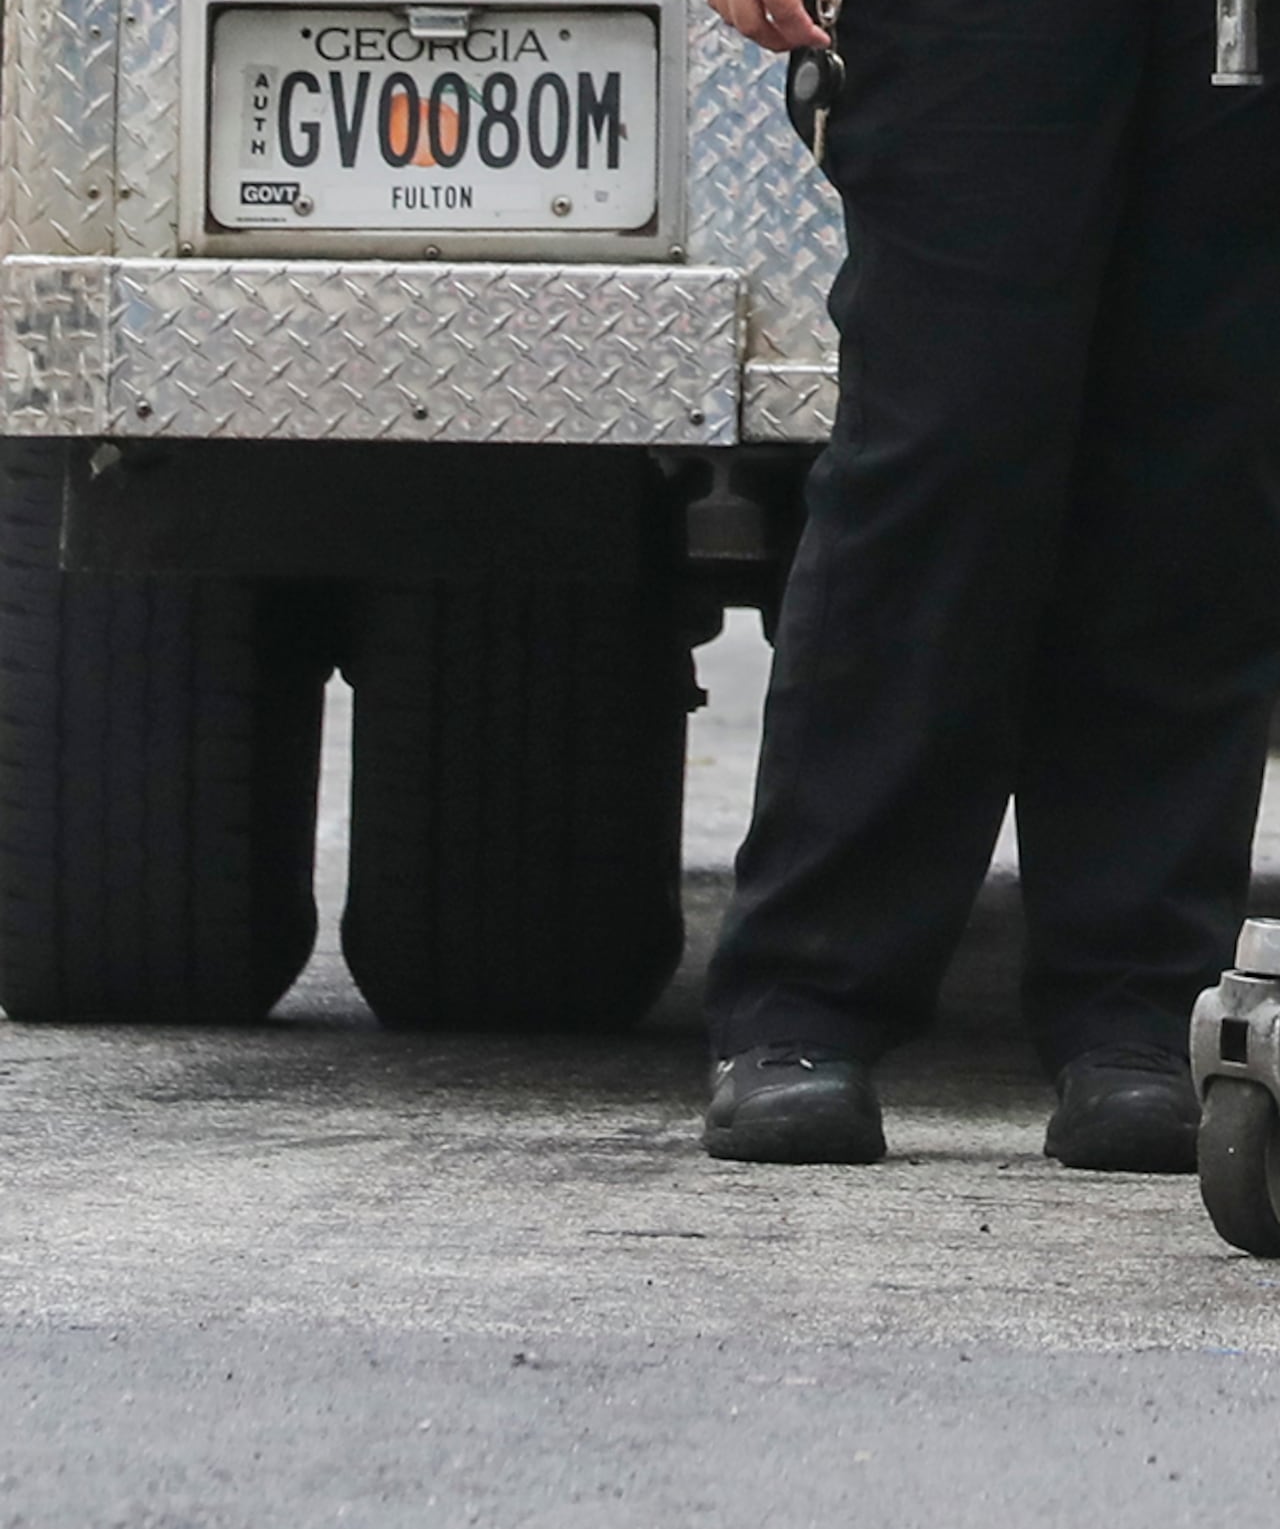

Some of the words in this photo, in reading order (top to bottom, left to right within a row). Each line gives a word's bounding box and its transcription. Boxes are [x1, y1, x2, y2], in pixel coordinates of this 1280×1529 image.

[315, 26, 549, 63] GEORGIA
[250, 72, 270, 157] AUTH
[242, 184, 299, 204] GOVT
[391, 185, 474, 210] FULTON
